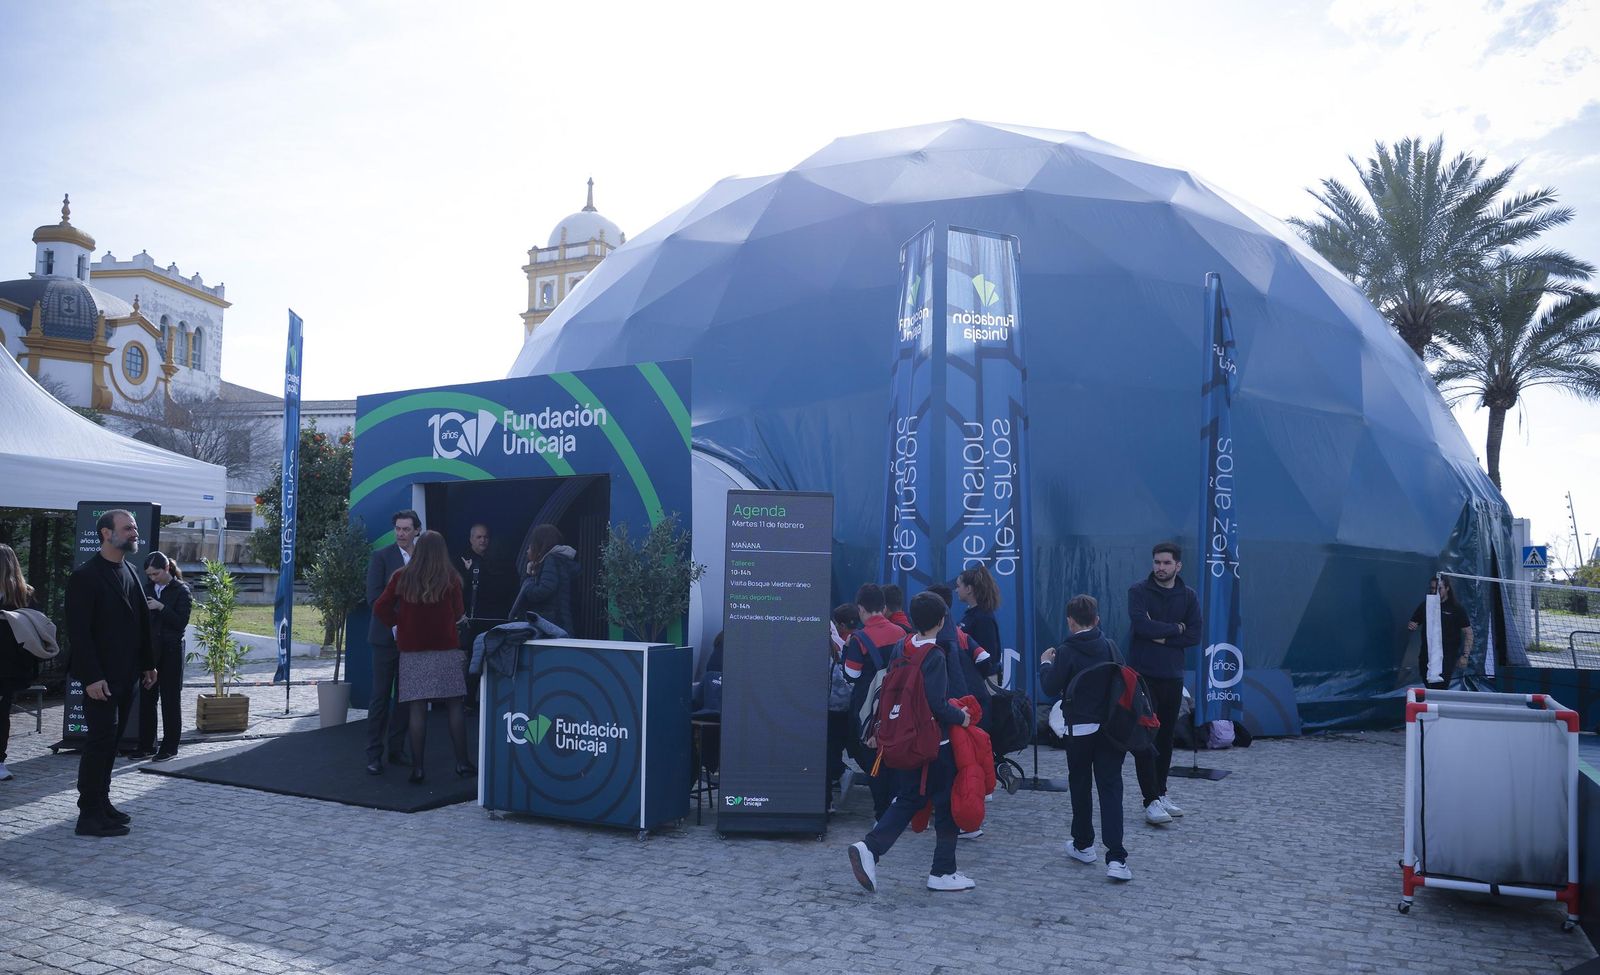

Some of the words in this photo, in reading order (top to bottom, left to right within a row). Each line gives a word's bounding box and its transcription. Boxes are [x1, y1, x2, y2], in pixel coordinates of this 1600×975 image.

[503, 403, 607, 432] Fundación
[441, 430, 459, 440] años
[503, 430, 577, 459] Unicaja
[1209, 436, 1234, 511] años
[733, 503, 787, 519] Agenda
[731, 520, 758, 529] Martes
[759, 520, 765, 528] 11
[766, 521, 776, 529] de
[777, 521, 805, 529] febrero
[1206, 516, 1230, 578] diez
[731, 559, 755, 567] Talleres
[747, 580, 770, 588] Bosque
[764, 614, 797, 622] deportivas
[1213, 659, 1237, 671] años
[556, 718, 629, 740] Fundación
[555, 734, 608, 757] Unicaja
